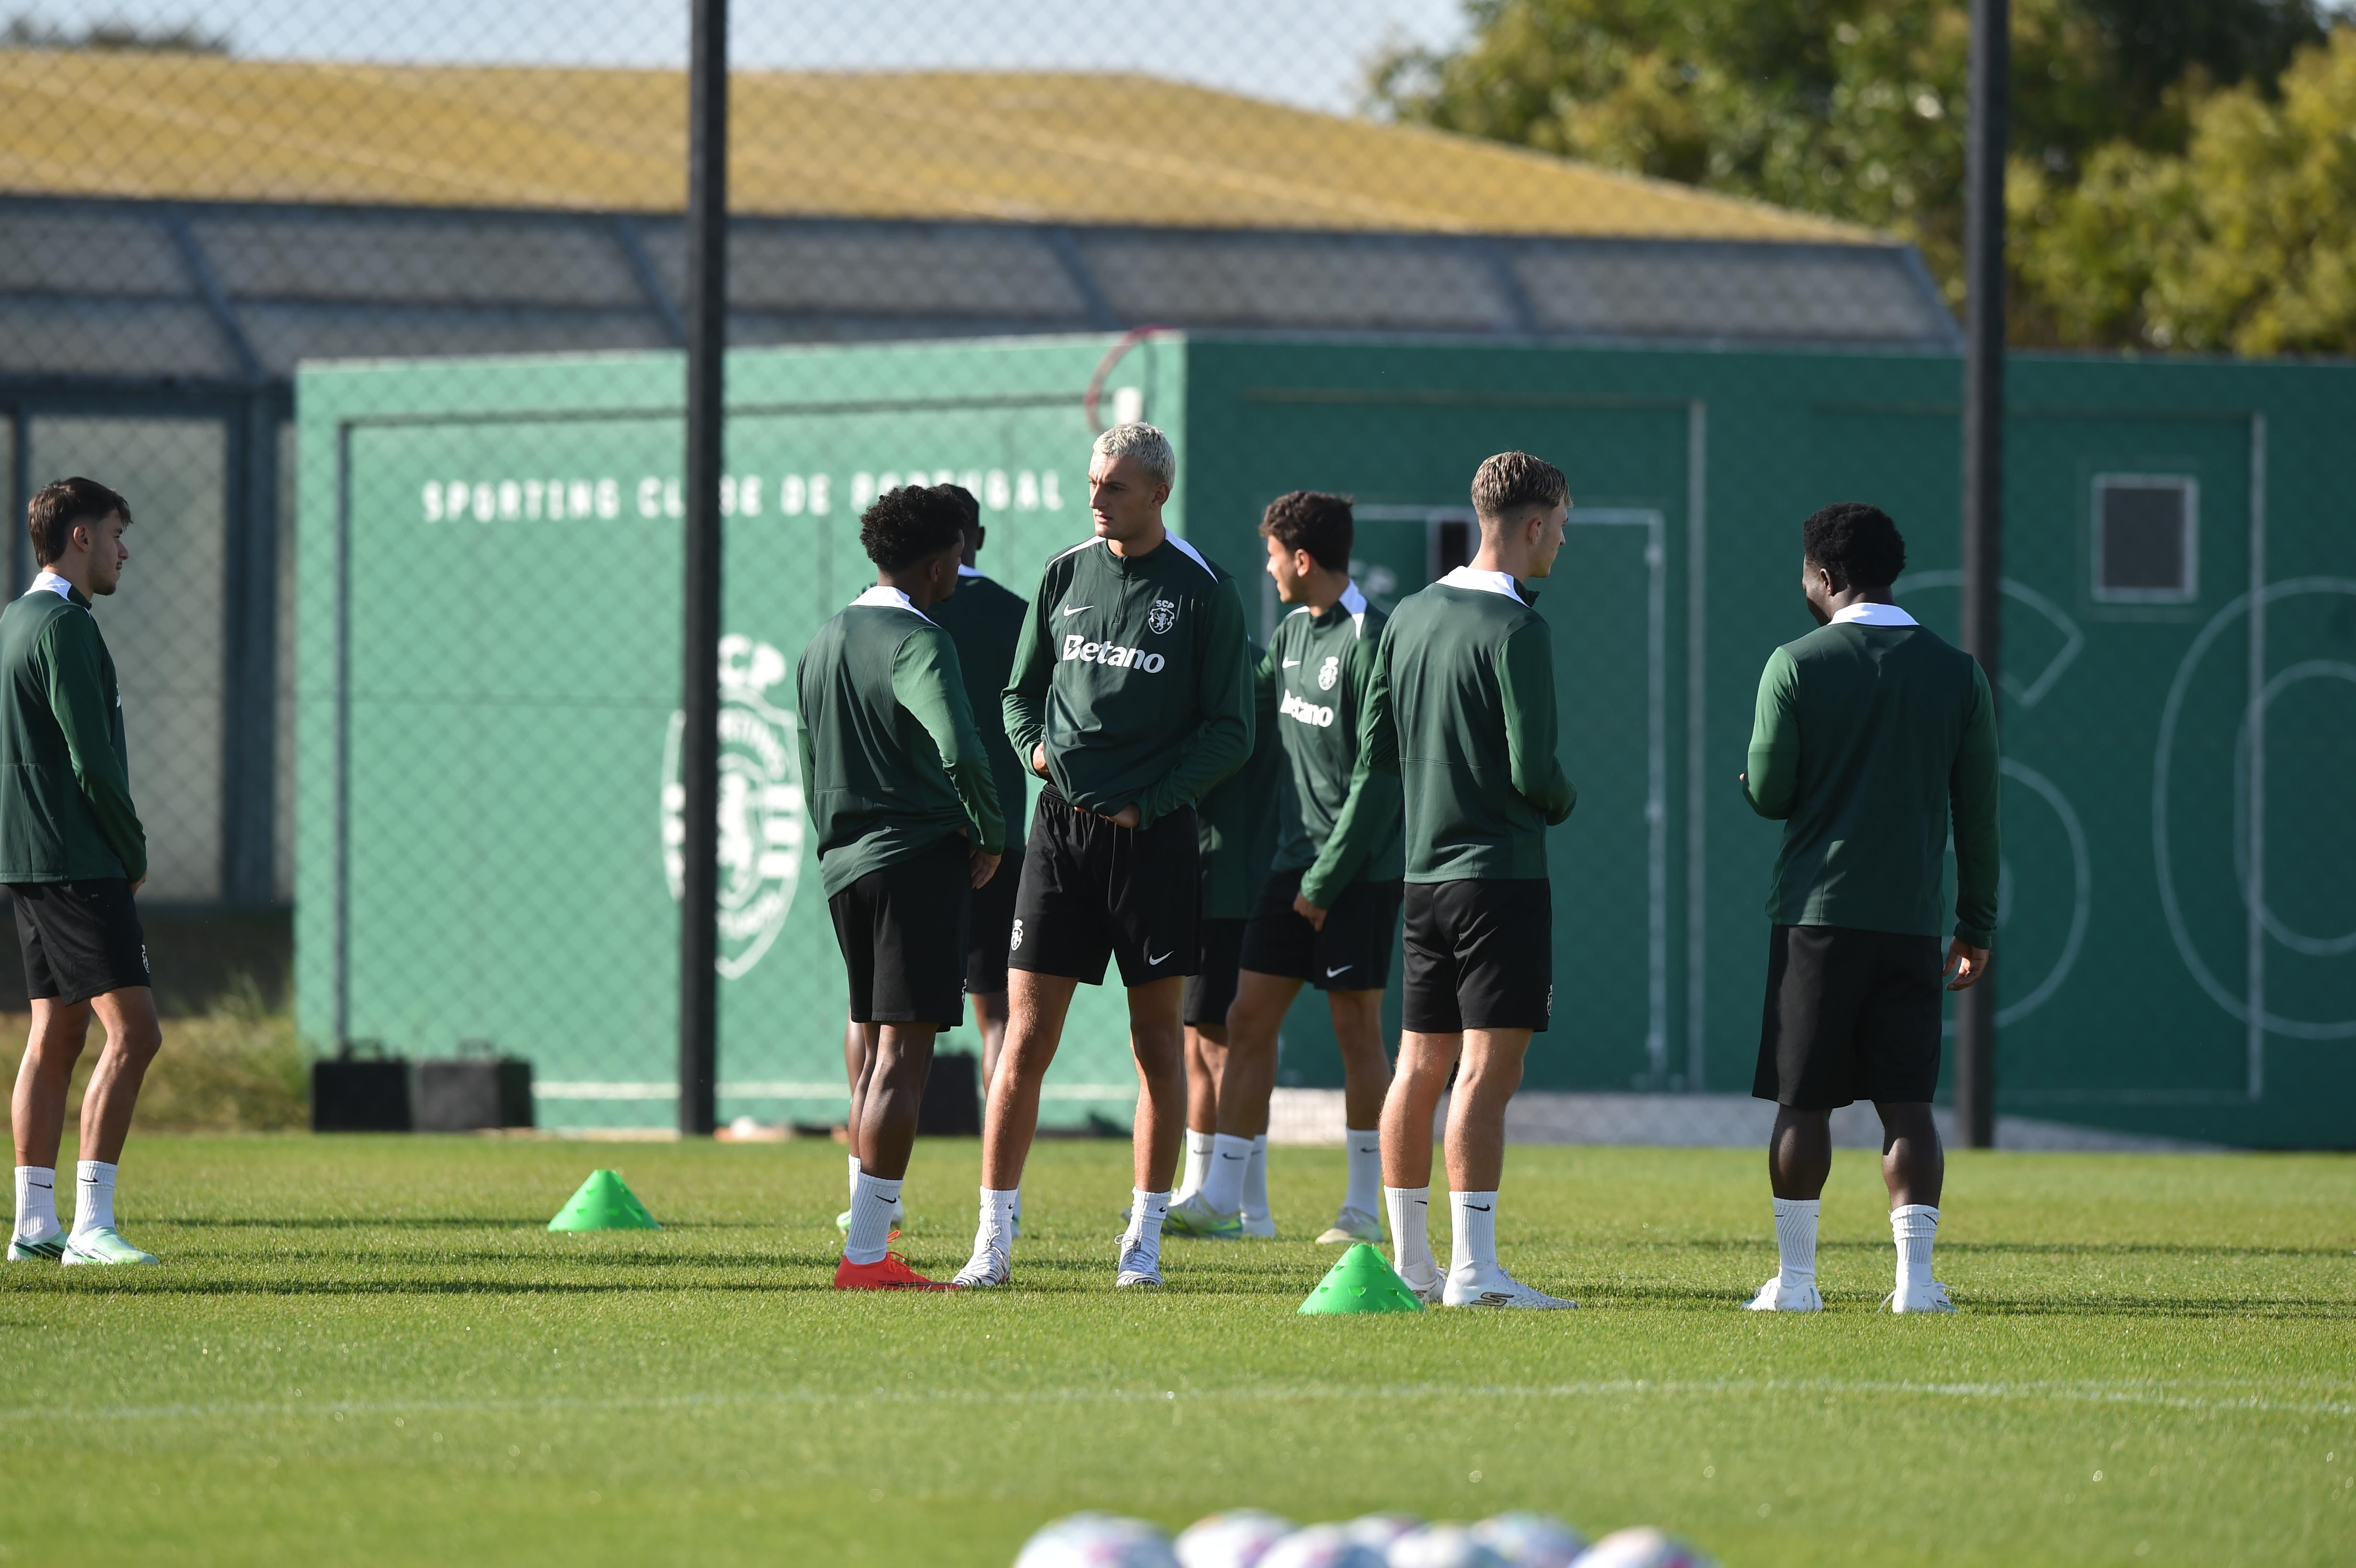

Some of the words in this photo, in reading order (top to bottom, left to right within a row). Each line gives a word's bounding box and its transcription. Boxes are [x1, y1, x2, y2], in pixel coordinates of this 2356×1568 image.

[422, 477, 621, 523] SPORTING
[637, 475, 764, 519] CLBE
[780, 472, 831, 517] DE
[1156, 599, 1175, 609] SCP
[1062, 634, 1165, 674] Betano
